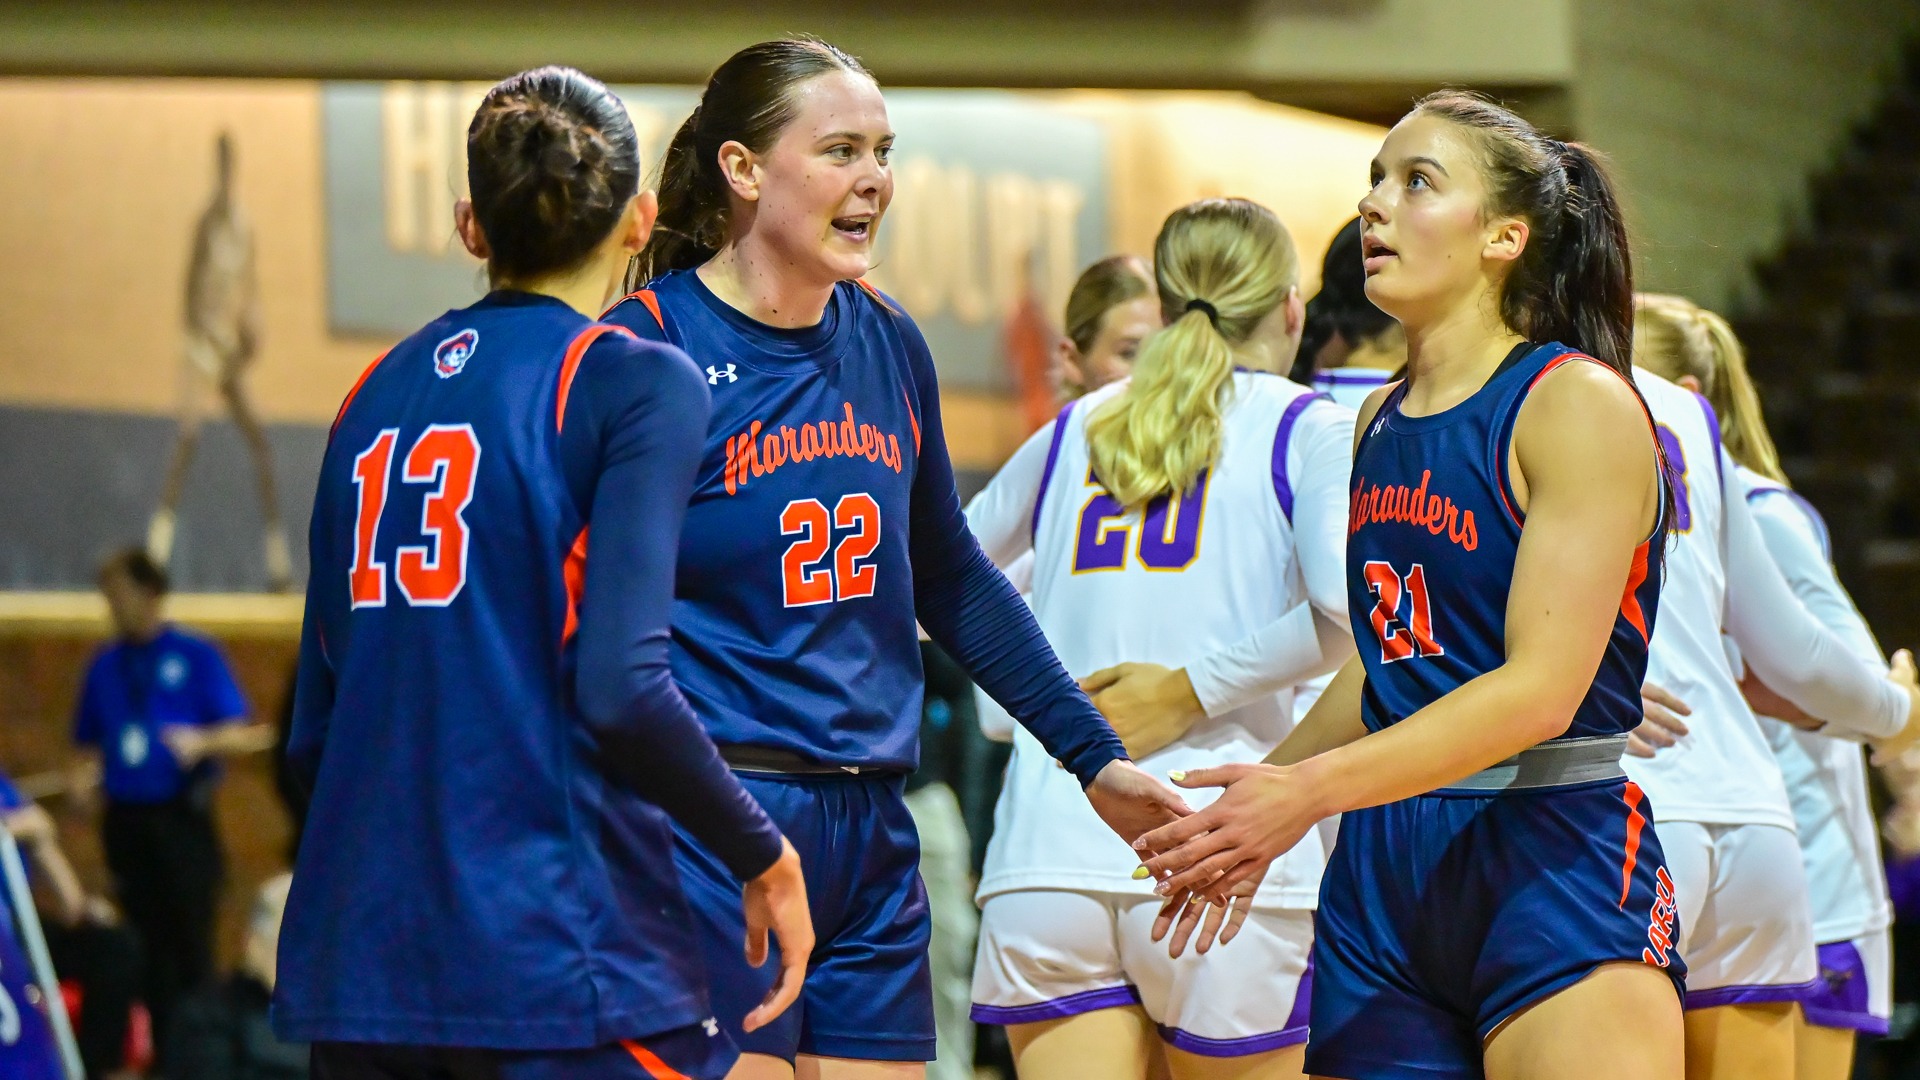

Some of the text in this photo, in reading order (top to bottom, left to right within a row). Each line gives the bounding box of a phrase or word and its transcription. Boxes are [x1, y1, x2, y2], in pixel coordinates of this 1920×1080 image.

[722, 401, 903, 496] Marauders
[348, 422, 482, 611] 13
[779, 492, 882, 608] 22
[1071, 463, 1214, 576] 20
[1363, 560, 1445, 664] 21
